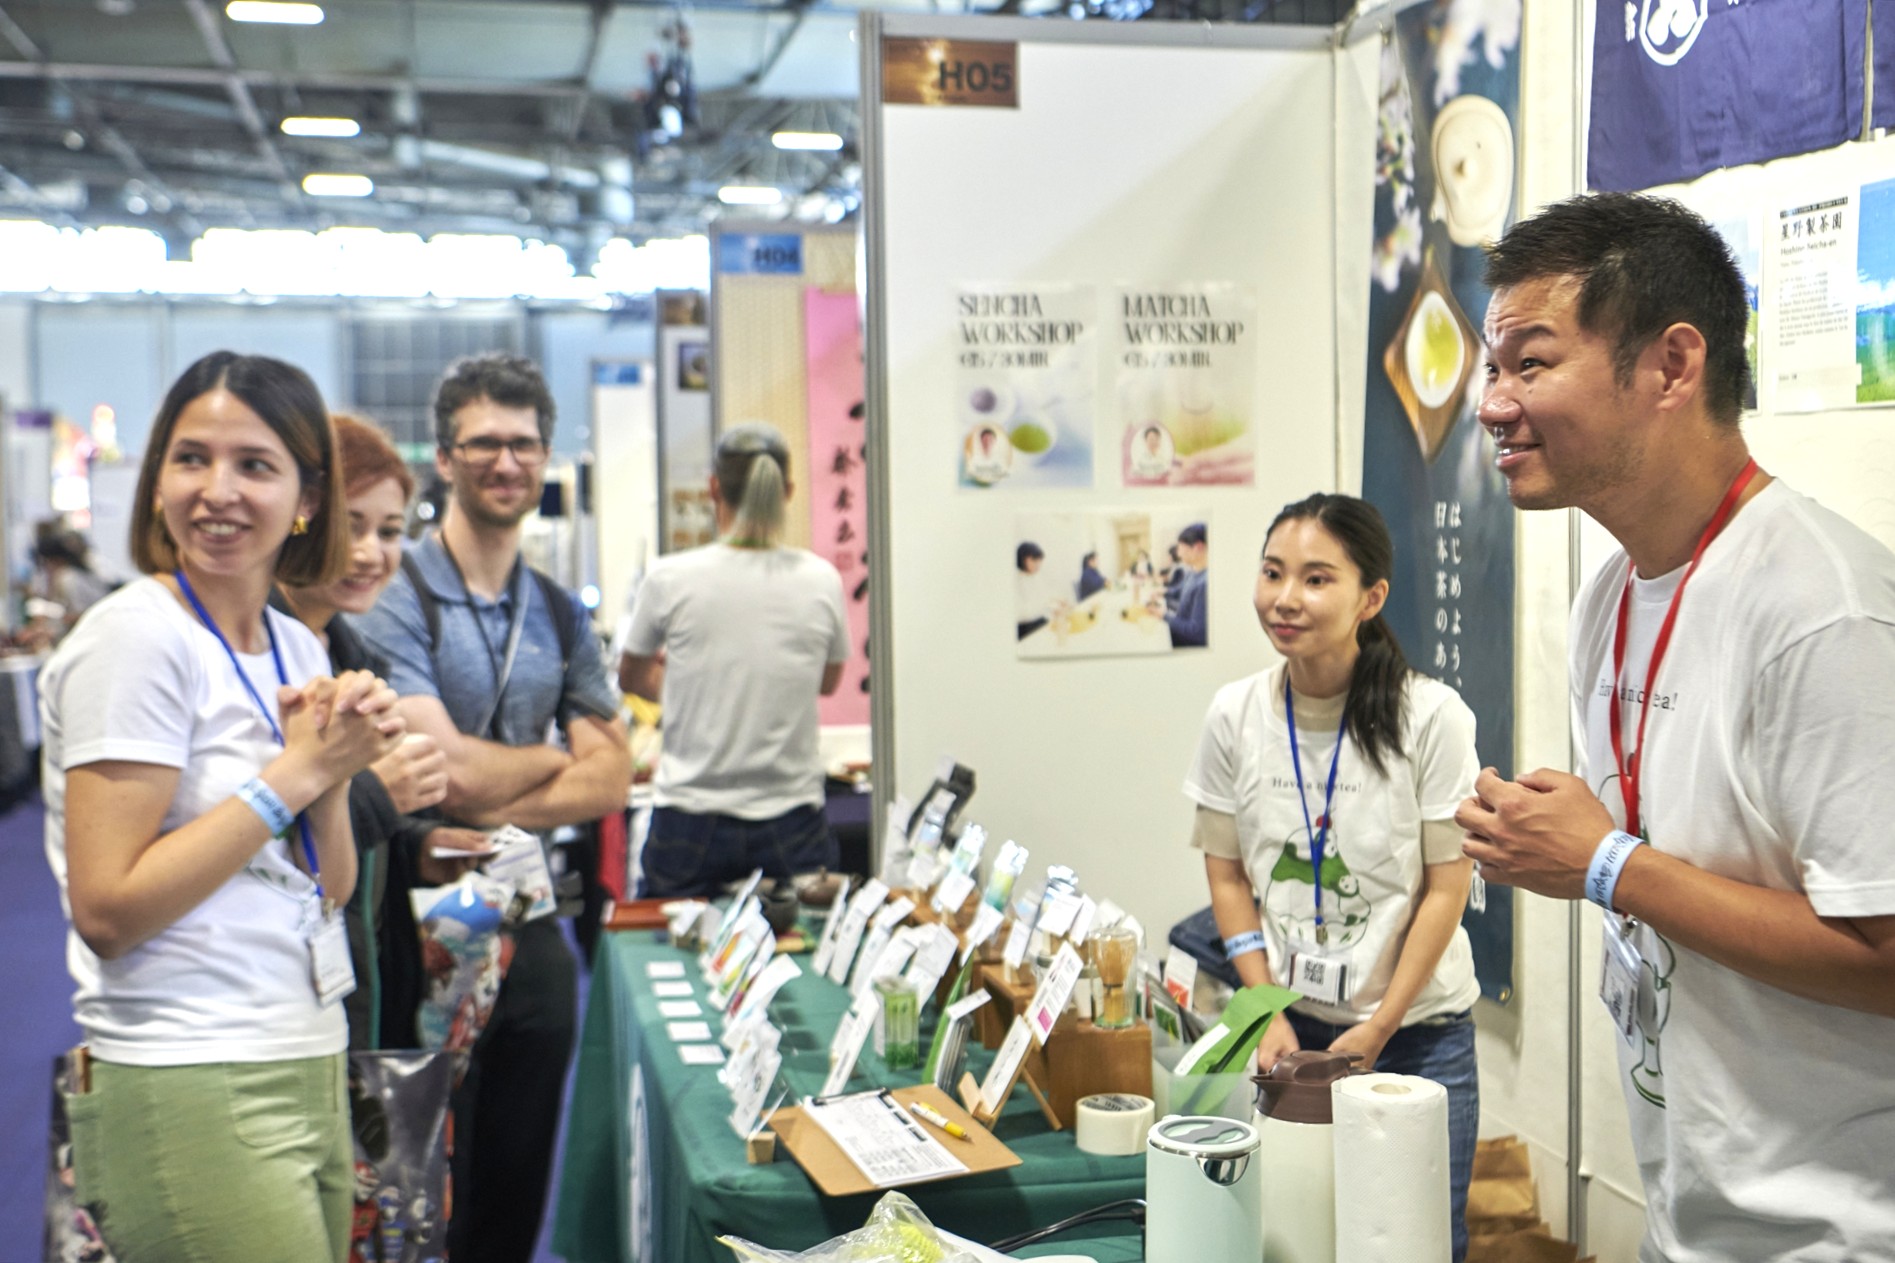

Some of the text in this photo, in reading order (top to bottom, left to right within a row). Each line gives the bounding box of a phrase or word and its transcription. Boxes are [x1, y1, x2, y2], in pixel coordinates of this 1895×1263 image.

[938, 61, 1012, 92] H05
[1123, 294, 1211, 318] MATCHA
[960, 321, 1083, 344] WORKSHOP
[1124, 321, 1244, 344] WORKSHOP
[1434, 501, 1449, 685] 日本茶のあ
[1272, 777, 1301, 789] Hav
